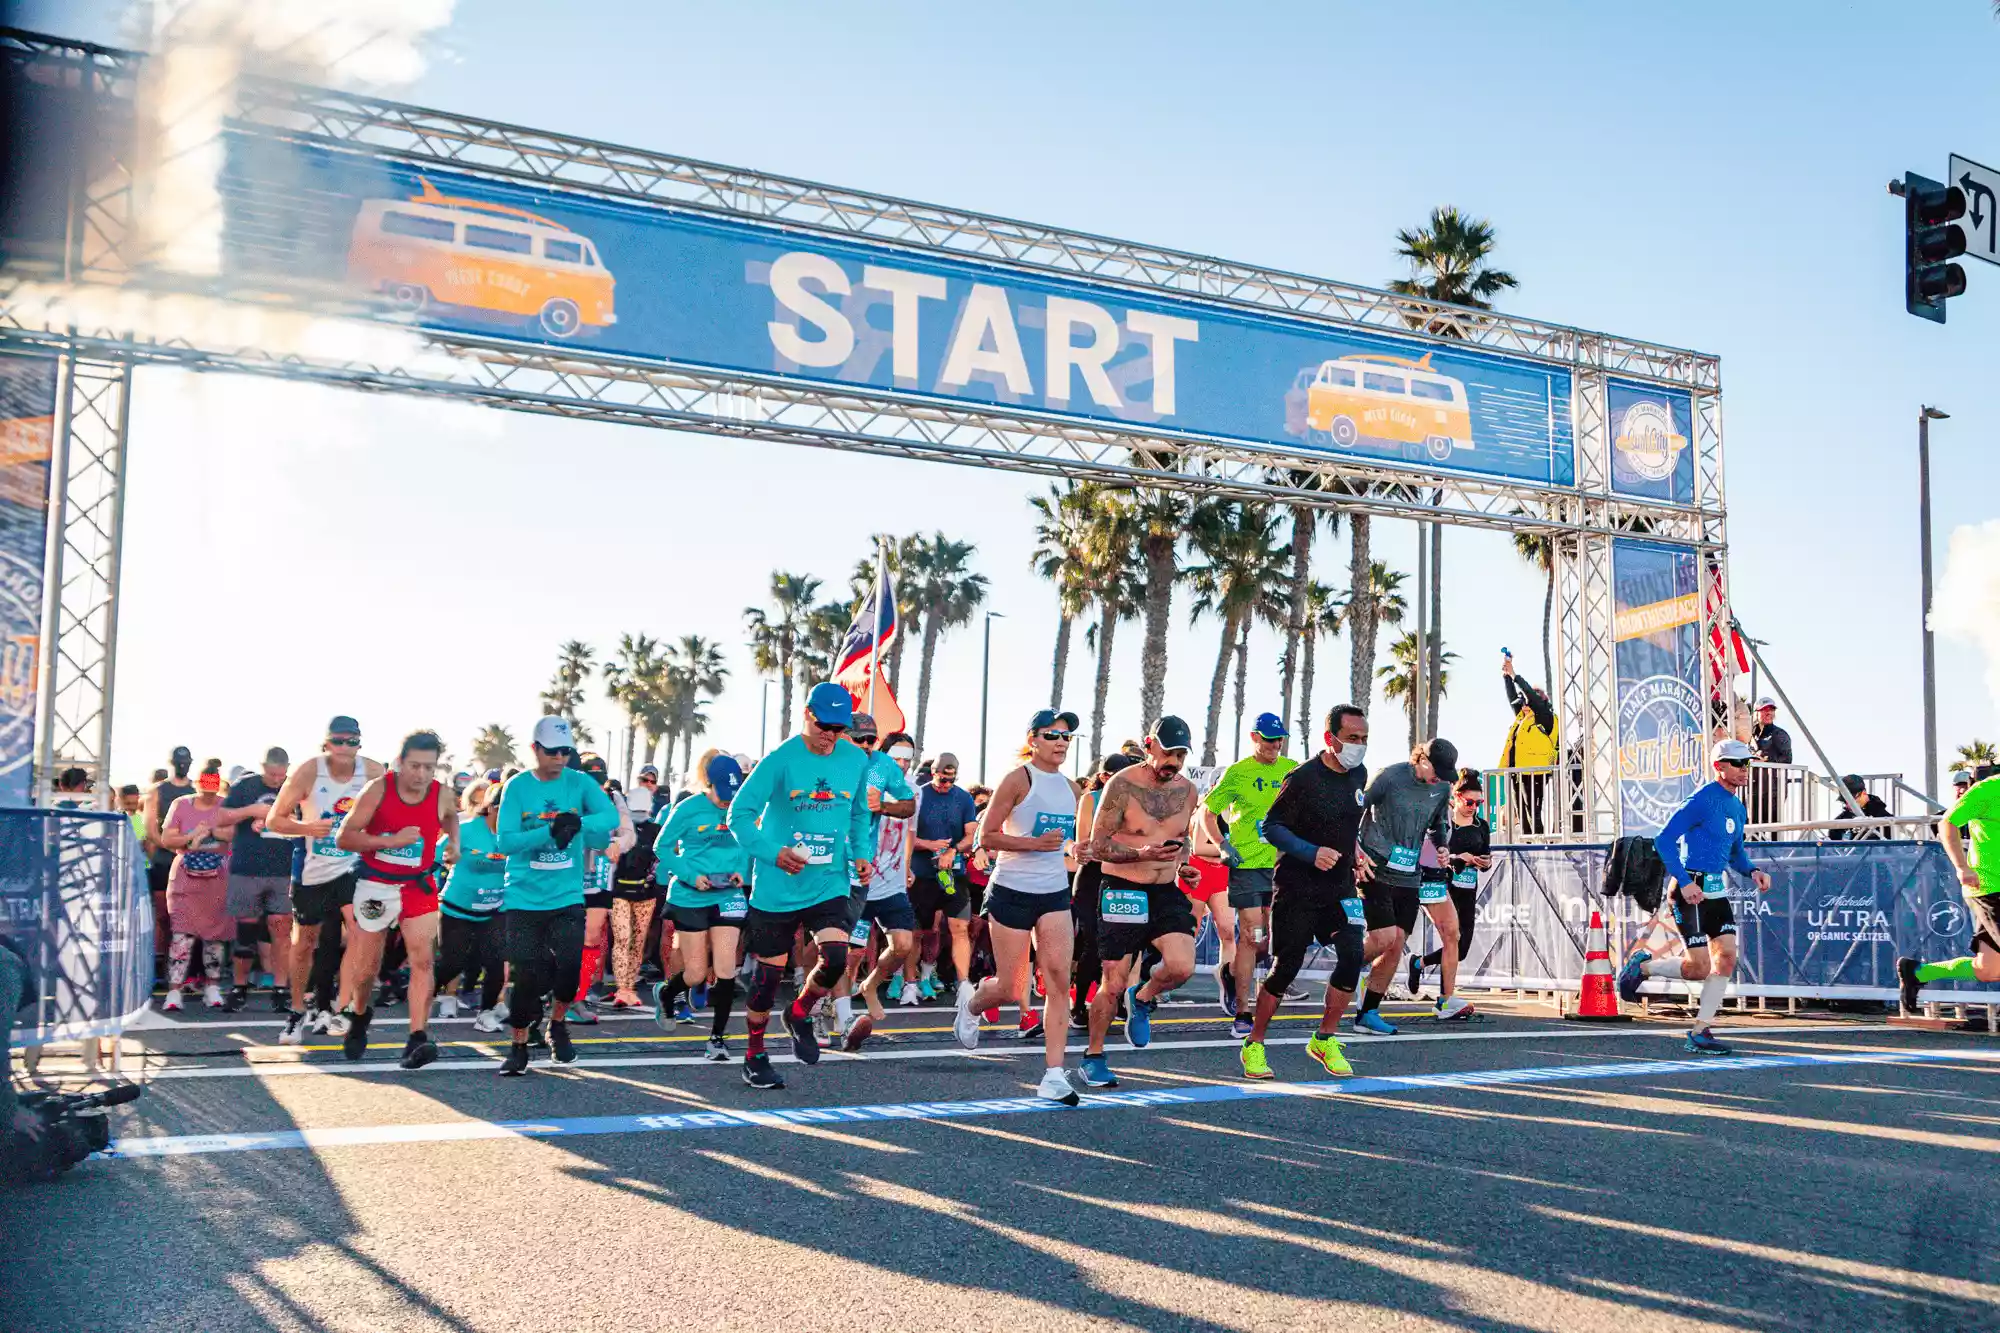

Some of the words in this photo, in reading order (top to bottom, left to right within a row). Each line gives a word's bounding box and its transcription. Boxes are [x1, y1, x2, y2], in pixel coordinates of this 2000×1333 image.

[768, 251, 1199, 415] START
[1624, 690, 1647, 720] HALF
[1622, 718, 1667, 781] Surf
[1667, 723, 1705, 788] City
[1188, 767, 1205, 779] YAY
[1109, 902, 1139, 914] 8298
[1730, 900, 1772, 916] TRA
[1819, 894, 1873, 908] Michelob
[1807, 909, 1890, 928] ULTRA
[1807, 931, 1850, 941] ORGANIC
[1852, 932, 1891, 942] SELTZER
